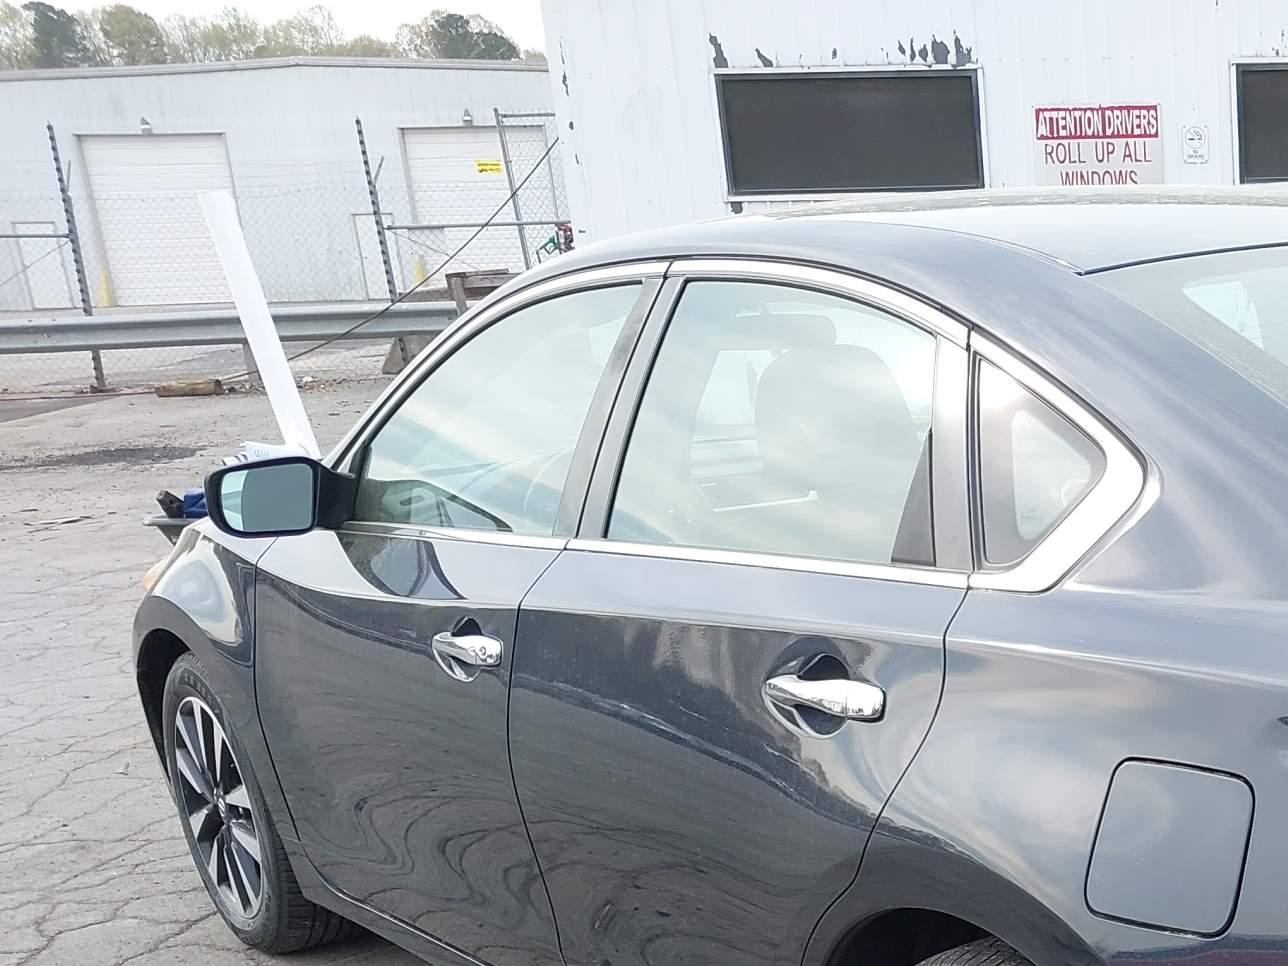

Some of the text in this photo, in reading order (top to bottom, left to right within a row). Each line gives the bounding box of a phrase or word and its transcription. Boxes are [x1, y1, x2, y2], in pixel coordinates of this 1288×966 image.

[1037, 108, 1157, 138] ATTENTION DRIVERS
[1045, 140, 1152, 164] ROLL UP ALL
